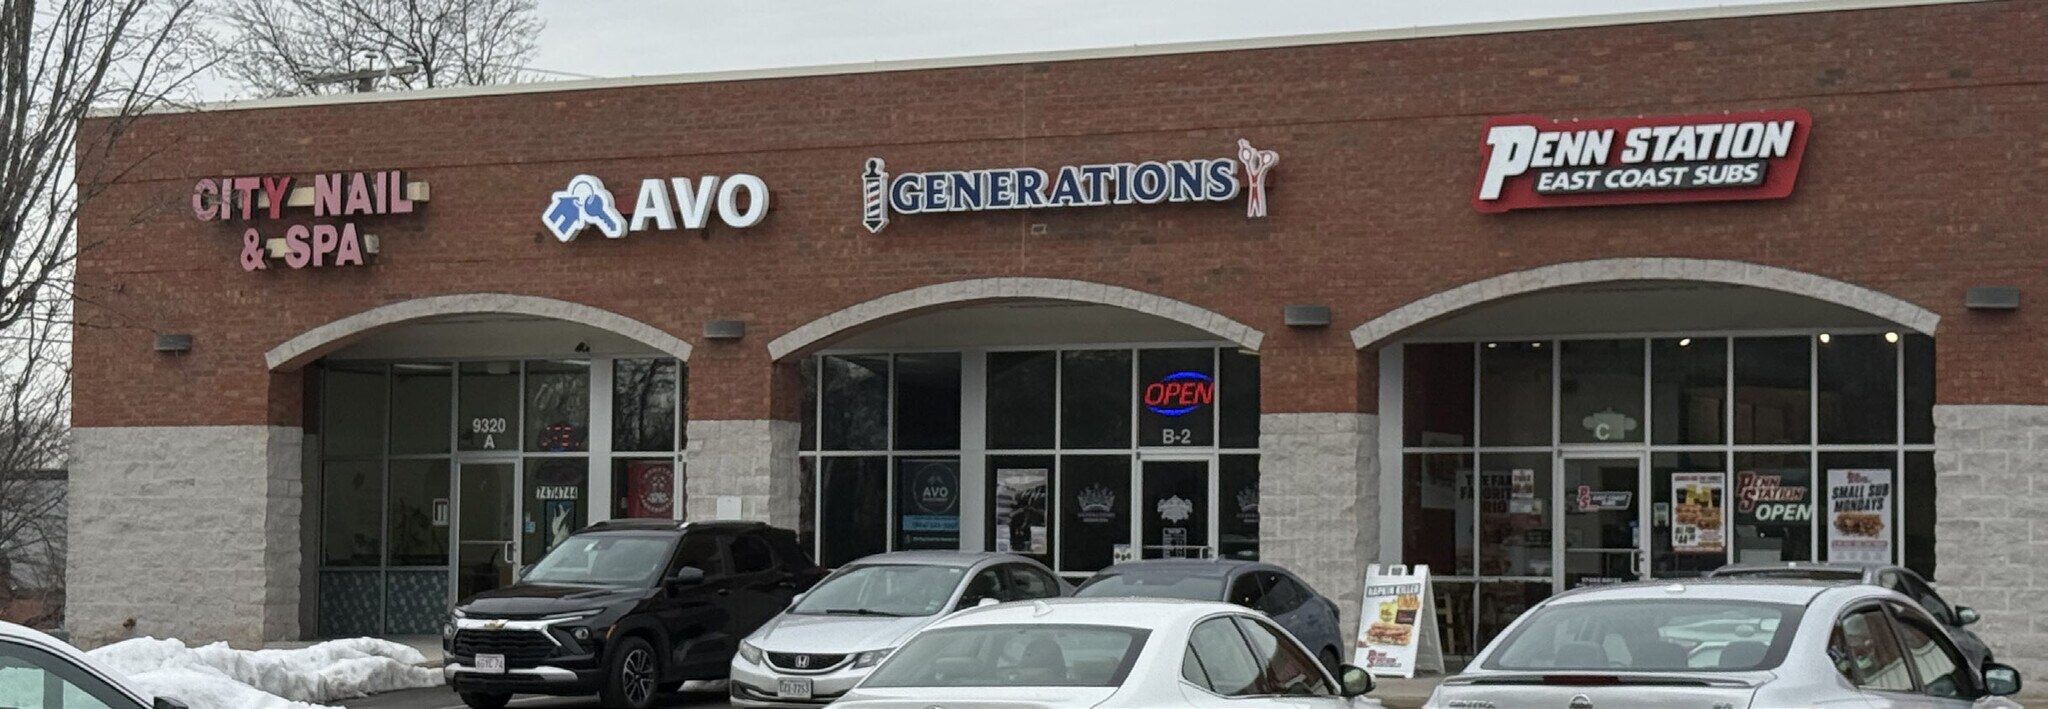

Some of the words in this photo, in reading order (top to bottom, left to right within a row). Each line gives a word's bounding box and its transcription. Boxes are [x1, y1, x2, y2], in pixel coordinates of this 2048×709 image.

[1479, 125, 1615, 200] PENN
[1620, 120, 1795, 164] STATION
[891, 158, 1239, 214] GENERATIONS
[1537, 169, 1601, 191] EAST
[1604, 166, 1689, 189] COAST
[1692, 163, 1760, 186] SUBS
[192, 176, 290, 221] CITY
[314, 170, 414, 217] NAIL
[629, 173, 770, 232] AVO
[240, 227, 267, 271] &
[284, 222, 364, 269] SPA
[1144, 382, 1215, 405] OPEN
[472, 418, 506, 433] 9320
[1162, 428, 1191, 444] B-2
[1595, 423, 1610, 440] C
[484, 434, 495, 449] A
[923, 486, 948, 497] AVO
[1738, 472, 1781, 494] PENN
[1832, 485, 1865, 500] SMALL
[1868, 483, 1889, 498] SUB
[1739, 487, 1803, 511] STATION
[1834, 497, 1885, 513] MONDAYS
[1755, 504, 1812, 521] OPEN
